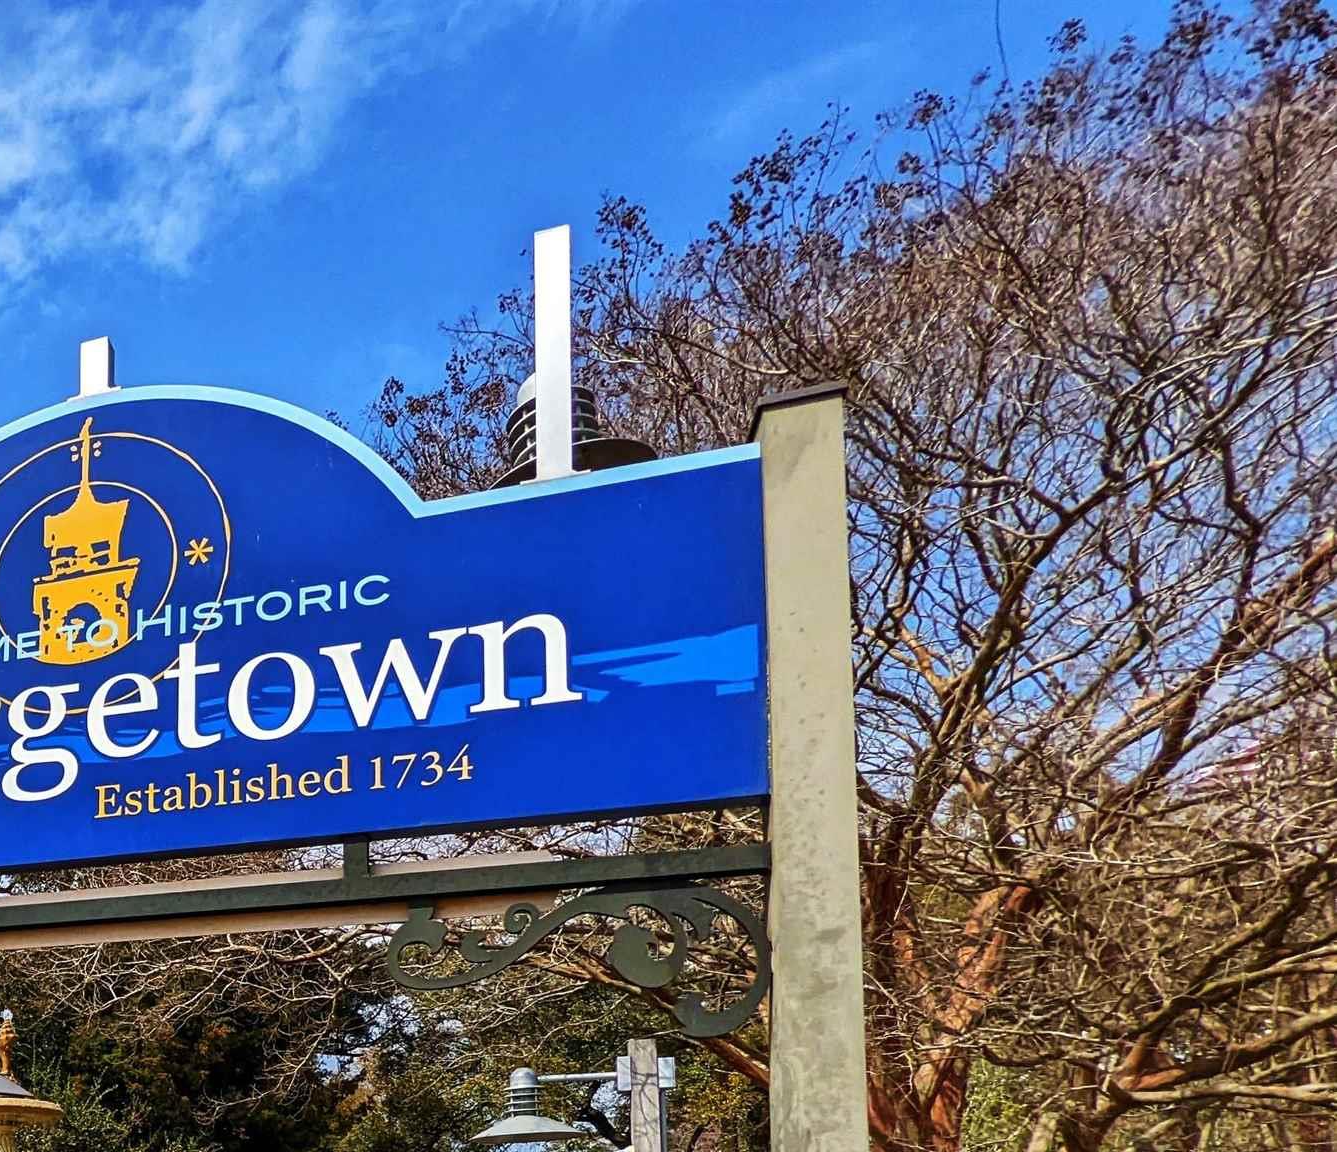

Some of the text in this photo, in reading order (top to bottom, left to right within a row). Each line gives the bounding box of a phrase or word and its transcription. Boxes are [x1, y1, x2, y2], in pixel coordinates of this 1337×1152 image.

[59, 619, 119, 652] TO
[136, 574, 391, 641] HISTORIC
[93, 744, 474, 819] Established 1734
